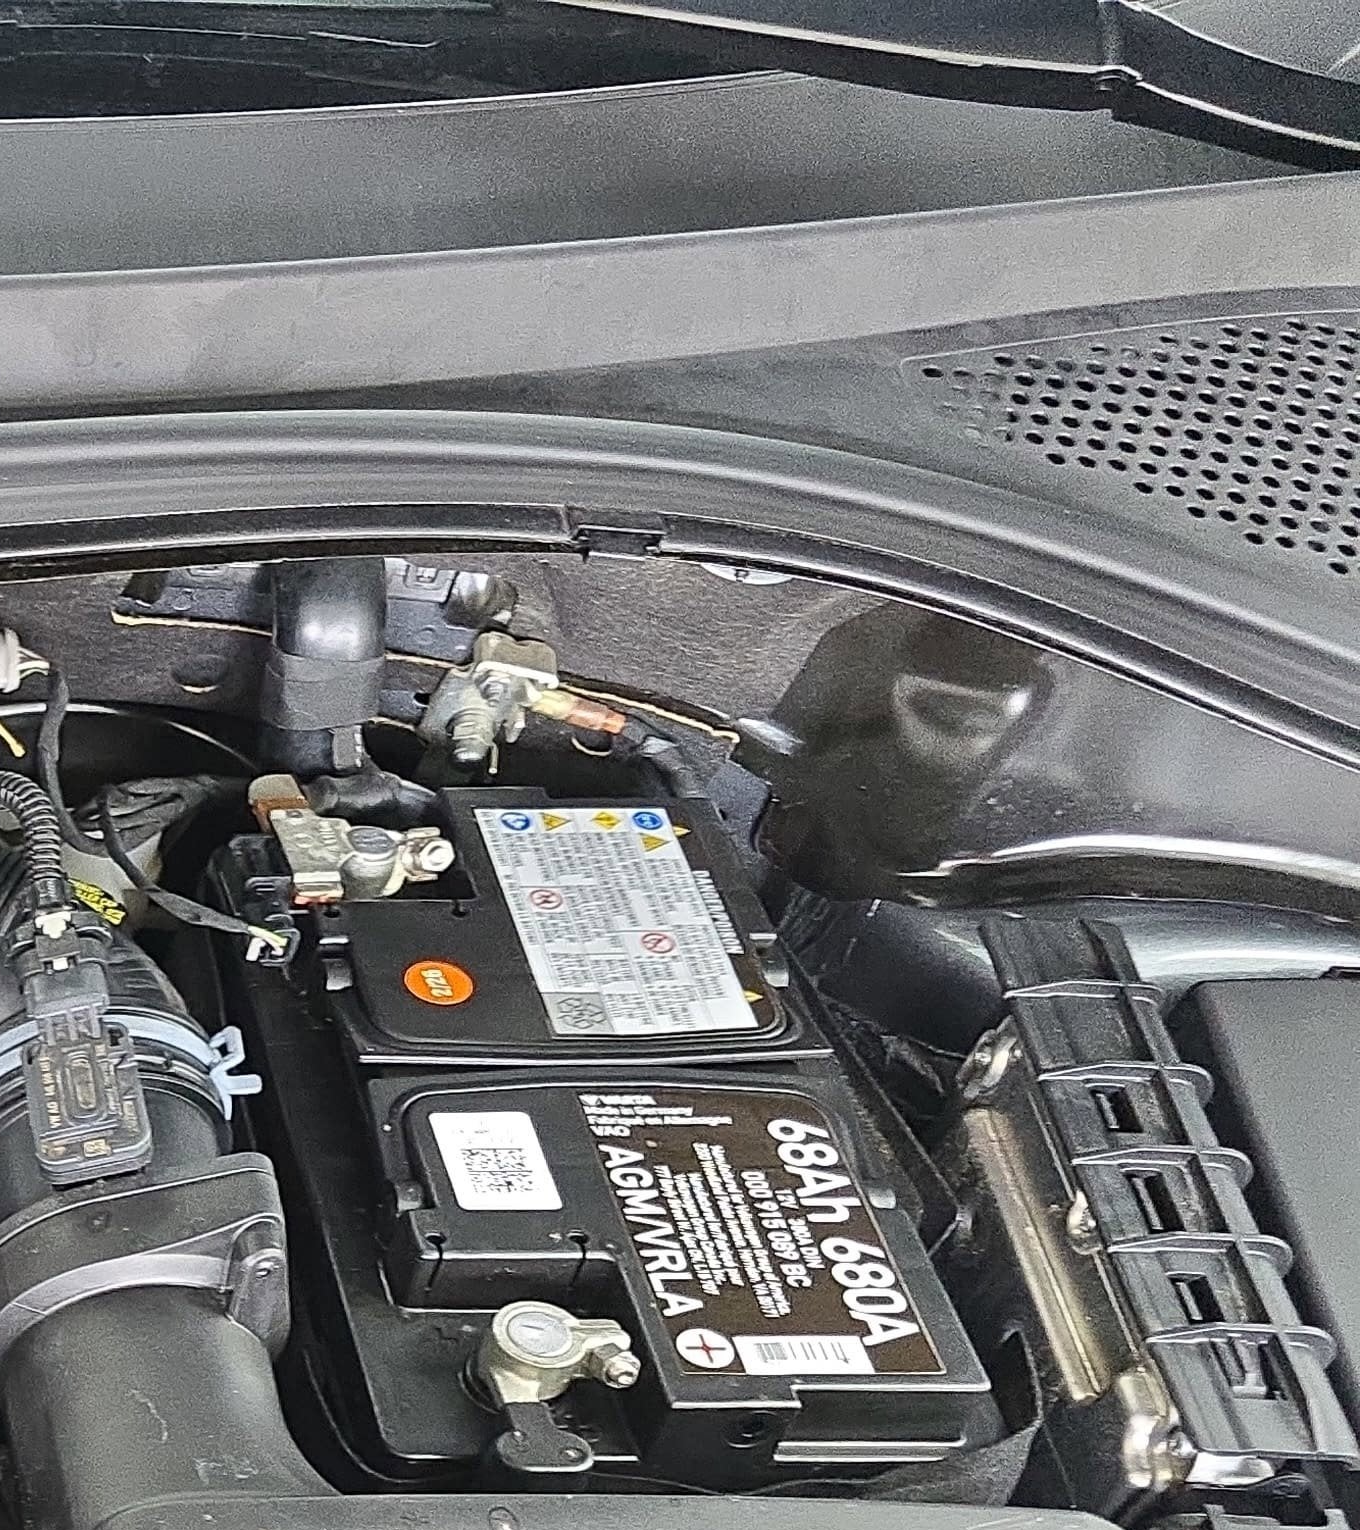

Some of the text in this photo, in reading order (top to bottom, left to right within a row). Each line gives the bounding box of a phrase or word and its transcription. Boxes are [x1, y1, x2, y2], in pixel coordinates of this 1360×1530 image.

[598, 1144, 703, 1316] AGM/VRLA
[740, 1170, 772, 1198] 000
[753, 1200, 787, 1228] 915
[767, 1118, 919, 1345] 68Ah 680A
